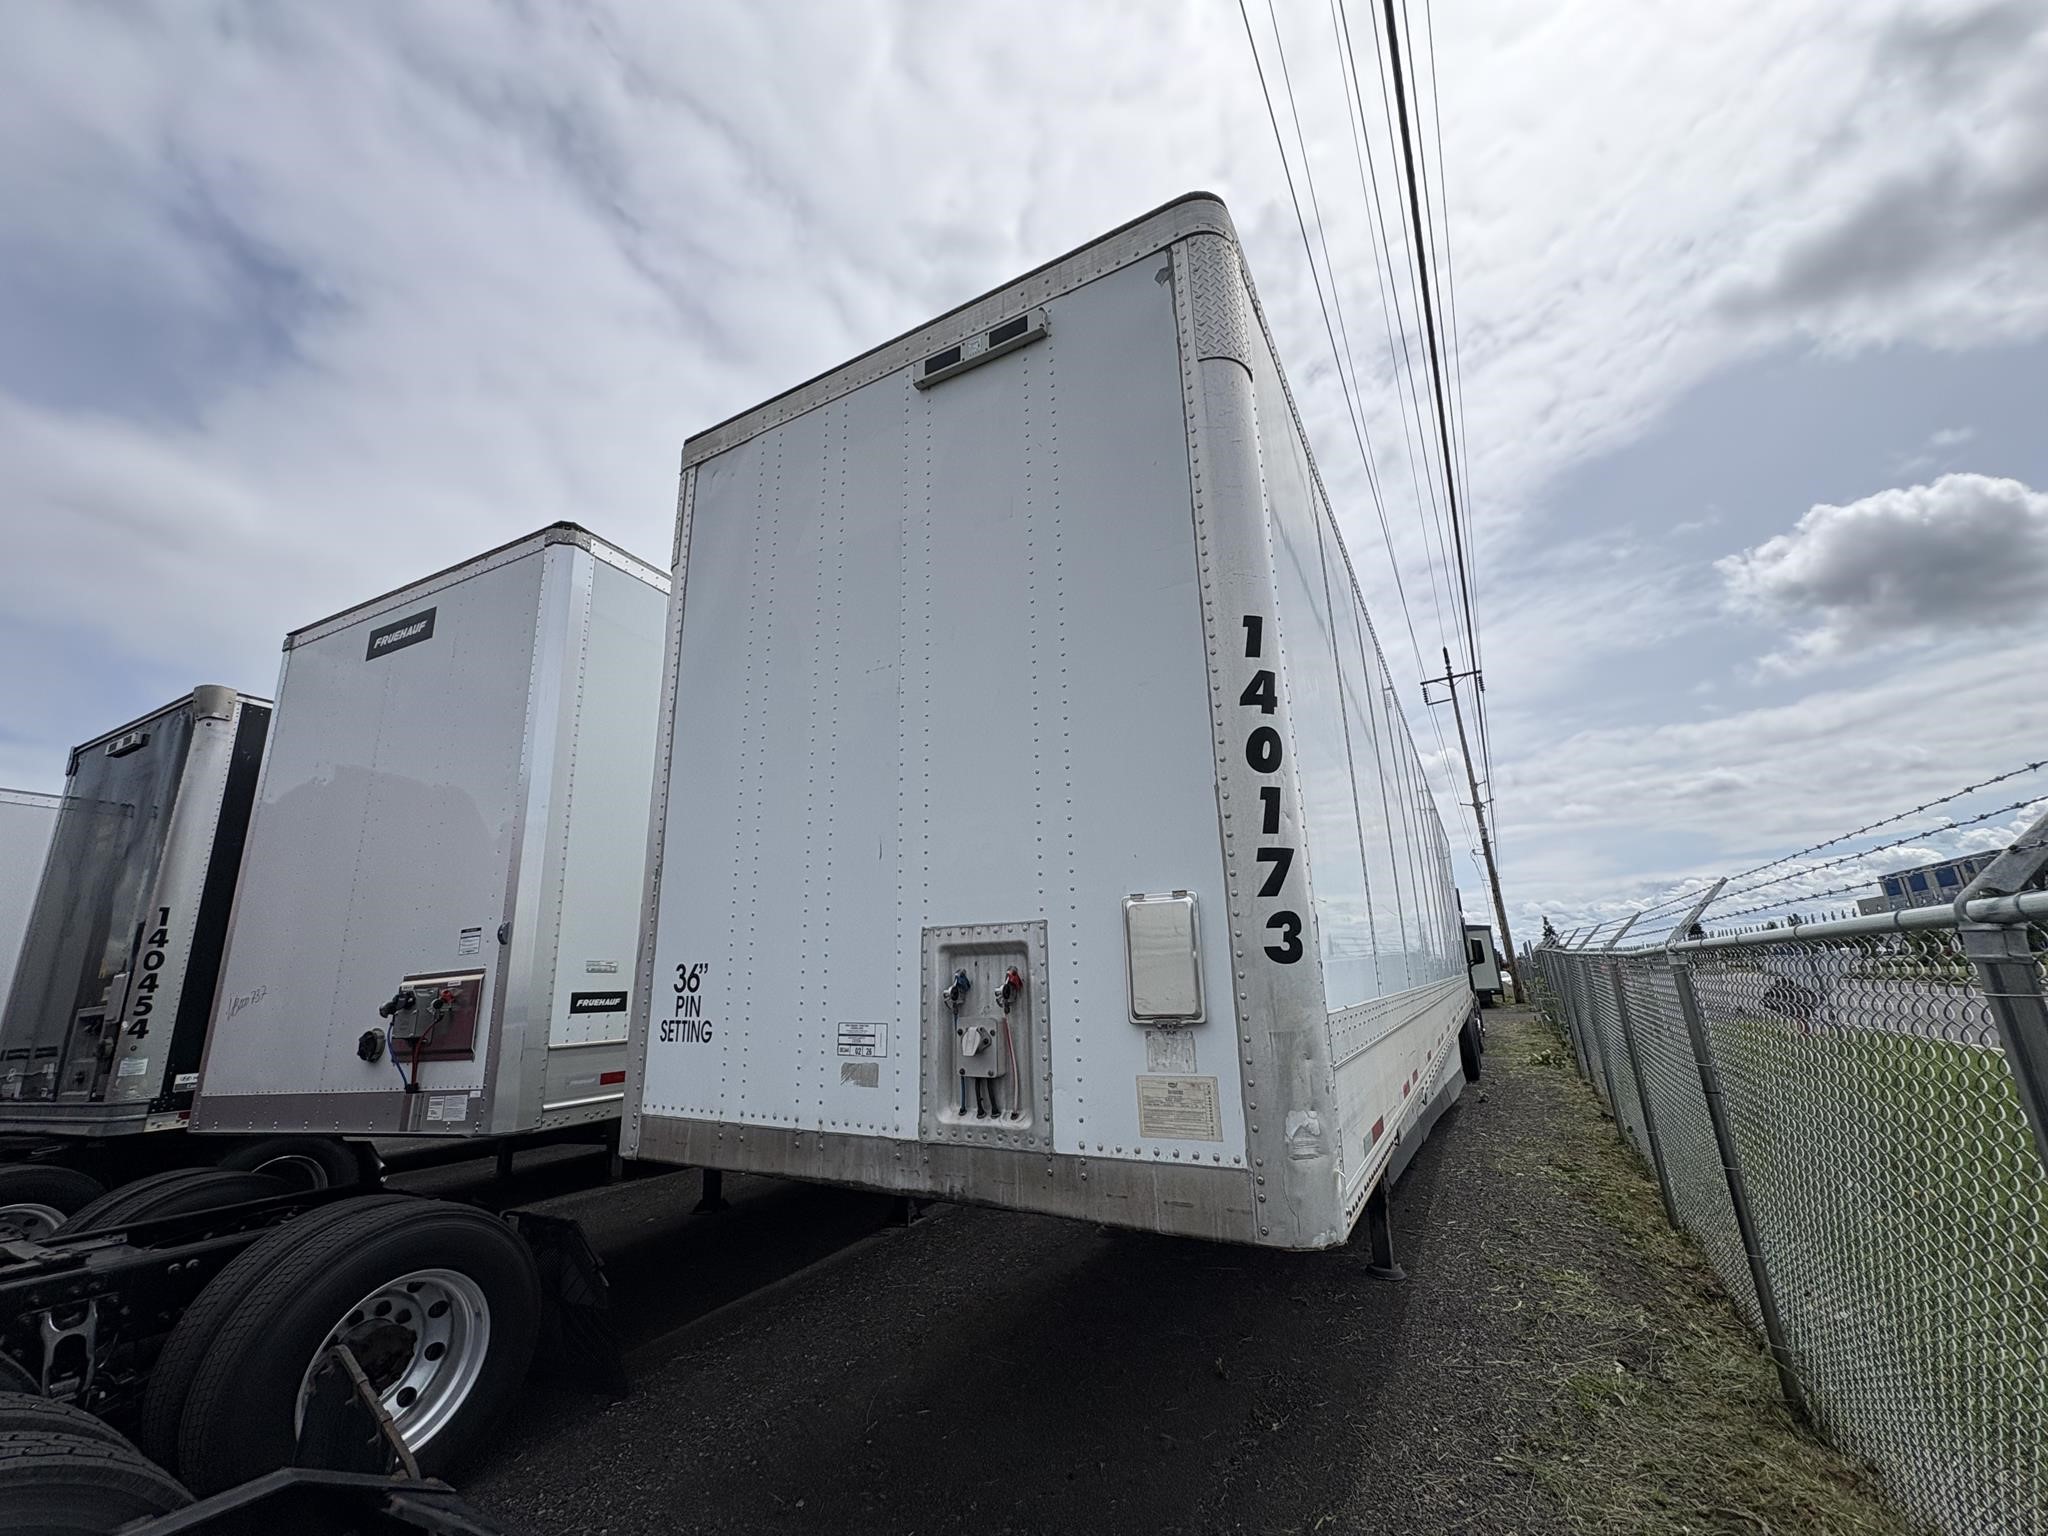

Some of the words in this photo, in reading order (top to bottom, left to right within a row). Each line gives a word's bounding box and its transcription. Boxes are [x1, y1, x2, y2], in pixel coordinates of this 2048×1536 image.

[373, 620, 427, 649] FRUEHAUF
[1239, 615, 1303, 964] 140173
[127, 907, 170, 1039] 140454
[576, 998, 621, 1007] FRUEHAUF
[675, 995, 701, 1018] PIN
[660, 1019, 712, 1043] SETTING
